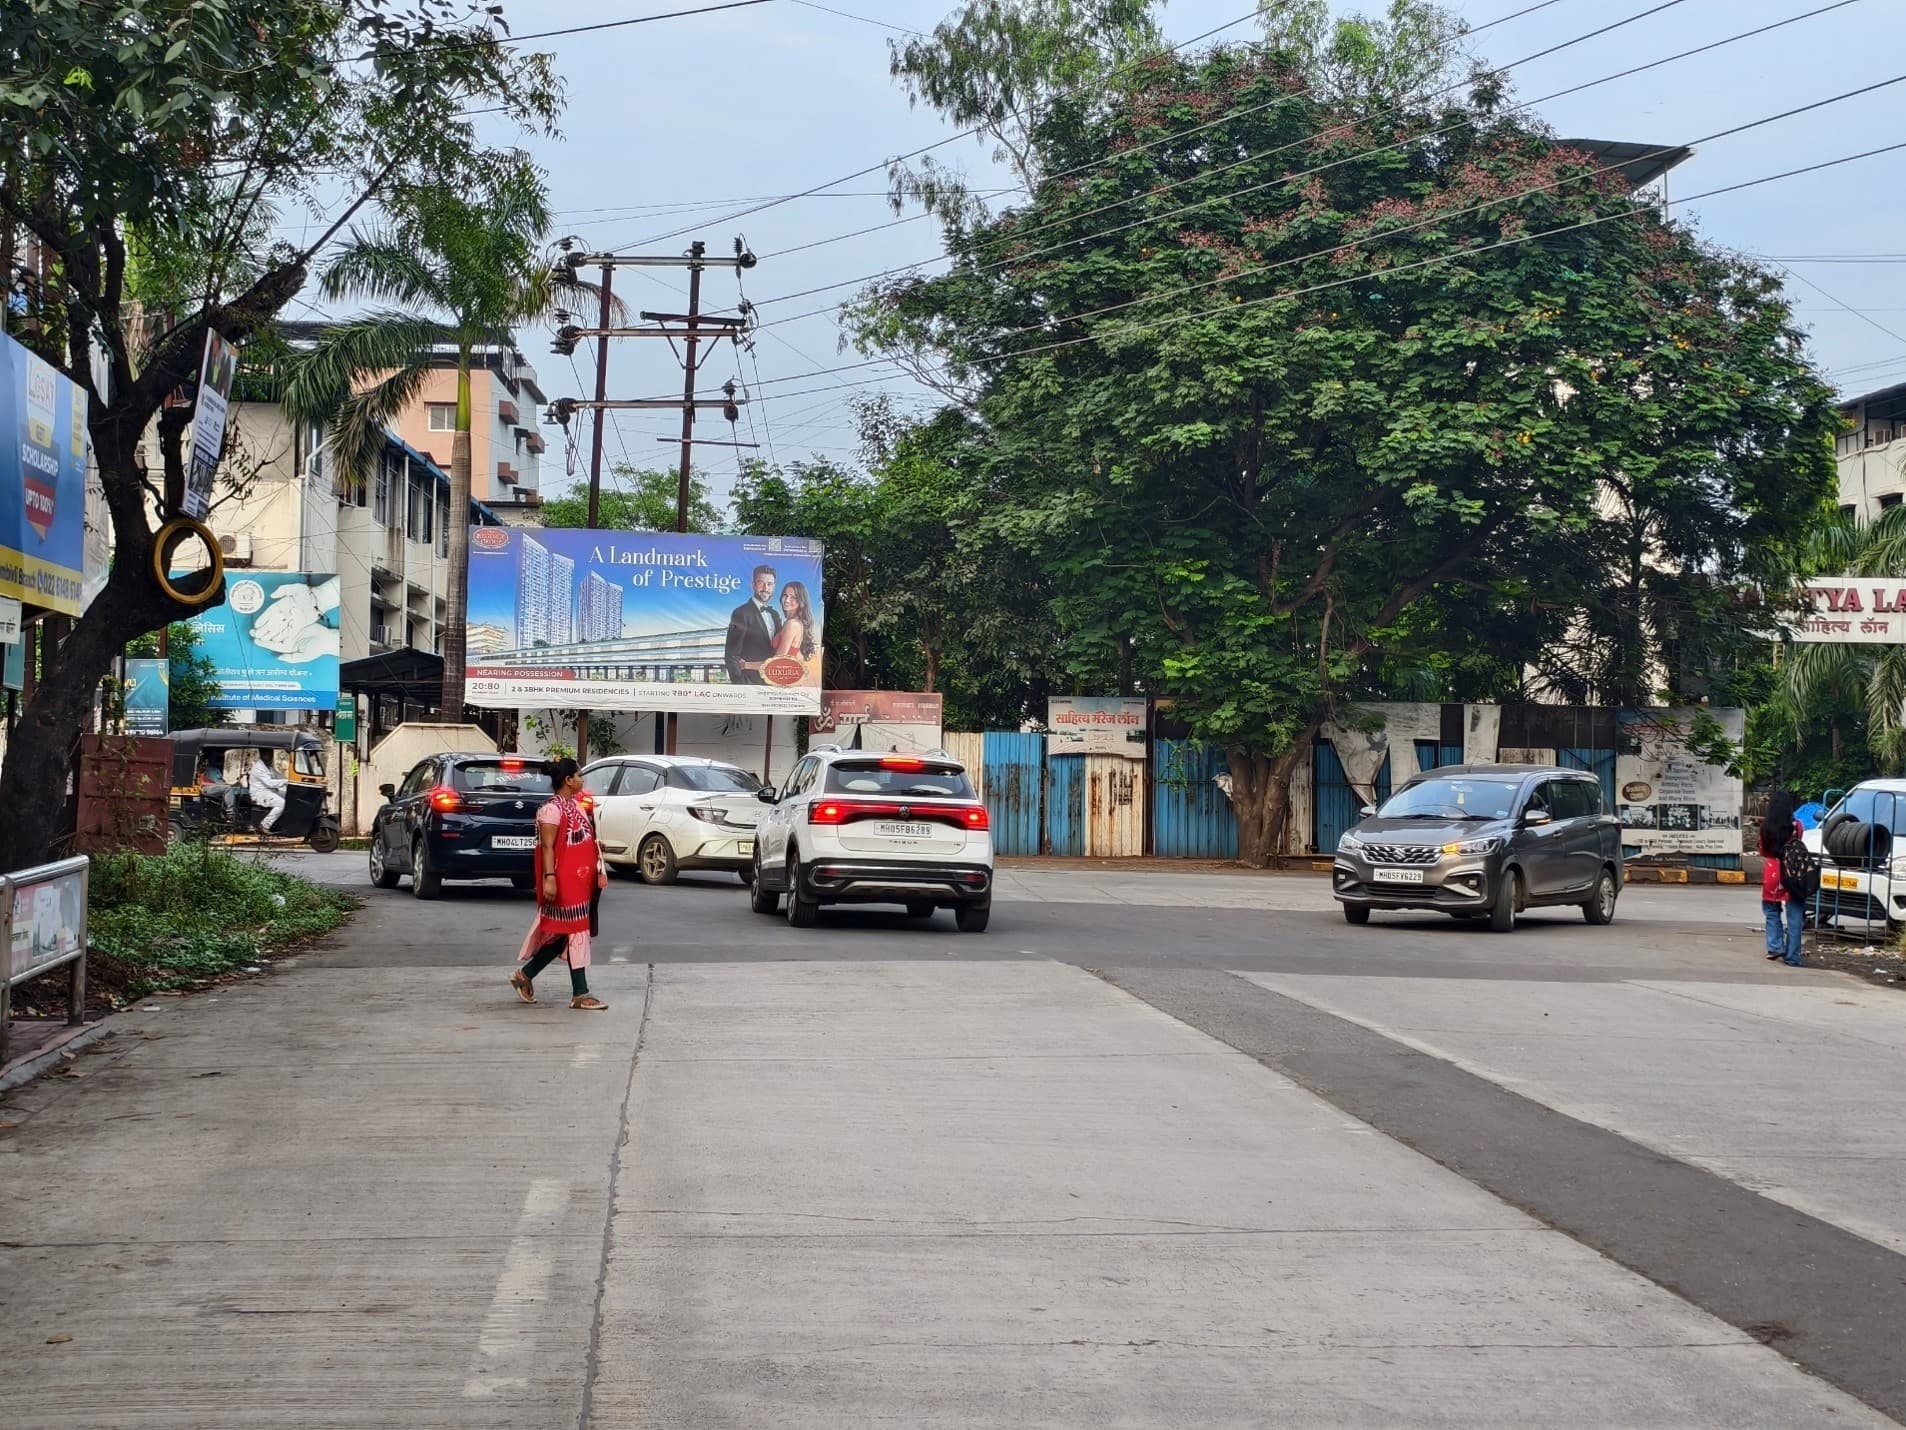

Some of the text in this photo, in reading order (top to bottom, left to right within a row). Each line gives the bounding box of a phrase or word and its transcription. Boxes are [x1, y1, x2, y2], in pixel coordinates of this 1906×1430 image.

[22, 443, 59, 477] SCHOLARSHIP
[589, 545, 708, 567] A Landmark
[633, 569, 741, 595] of Prestige
[1860, 617, 1889, 634] लॉन
[476, 669, 563, 678] NEARING POSSESSION
[472, 682, 500, 690] 20:80
[282, 694, 316, 703] Sciences
[1056, 710, 1089, 725] साहित्य
